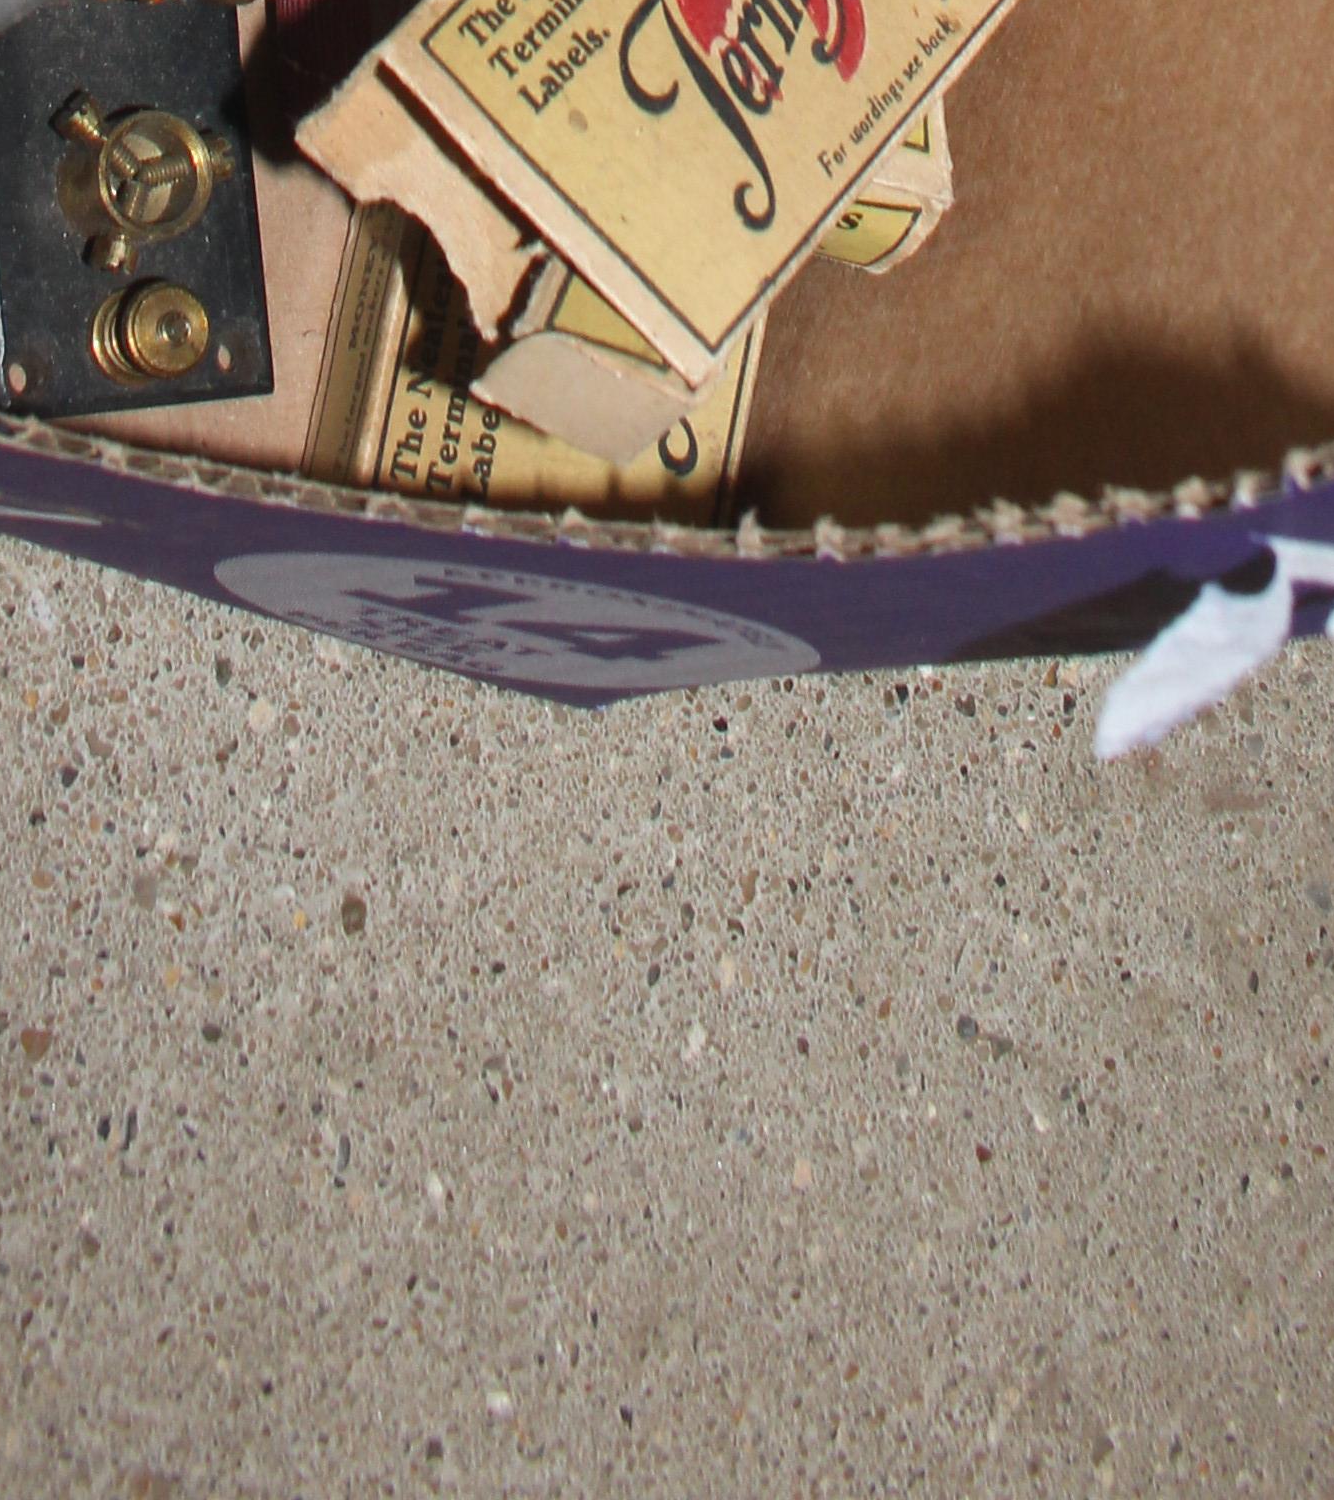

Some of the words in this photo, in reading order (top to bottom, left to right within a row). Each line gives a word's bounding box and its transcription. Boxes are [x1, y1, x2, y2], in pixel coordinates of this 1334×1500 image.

[516, 26, 613, 116] Labels.
[816, 142, 849, 179] For
[849, 77, 906, 145] wordings
[901, 50, 928, 80] see
[390, 405, 429, 483] The
[460, 405, 502, 500] Labe
